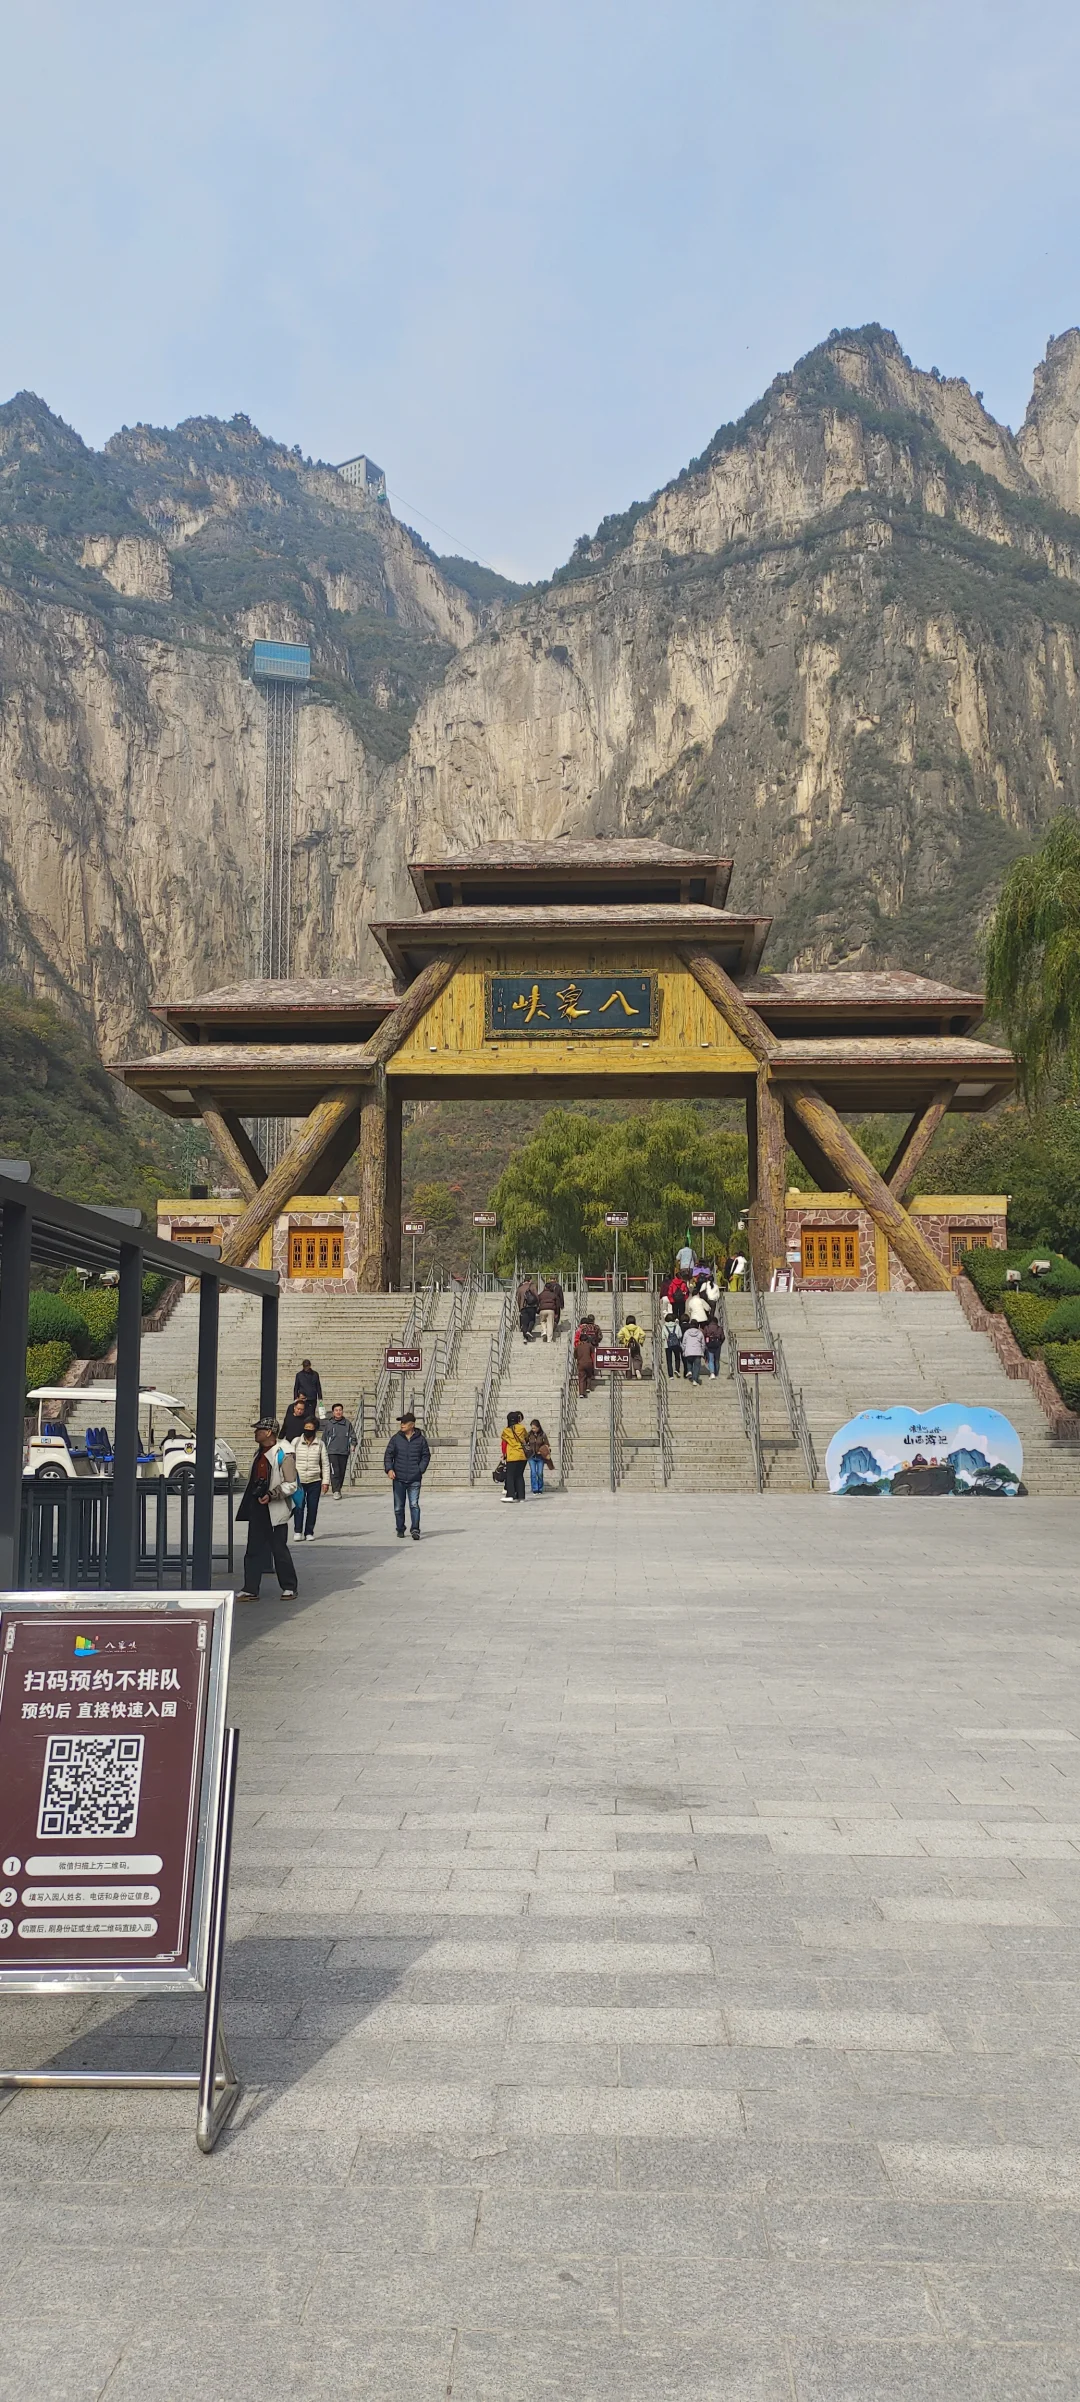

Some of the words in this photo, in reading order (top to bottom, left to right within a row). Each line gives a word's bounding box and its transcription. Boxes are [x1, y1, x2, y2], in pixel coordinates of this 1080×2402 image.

[904, 1435, 948, 1445] 山西游记
[24, 1668, 181, 1691] 扫码预约不排队
[21, 1702, 72, 1719] 预约后
[76, 1701, 177, 1719] 直接快速入园
